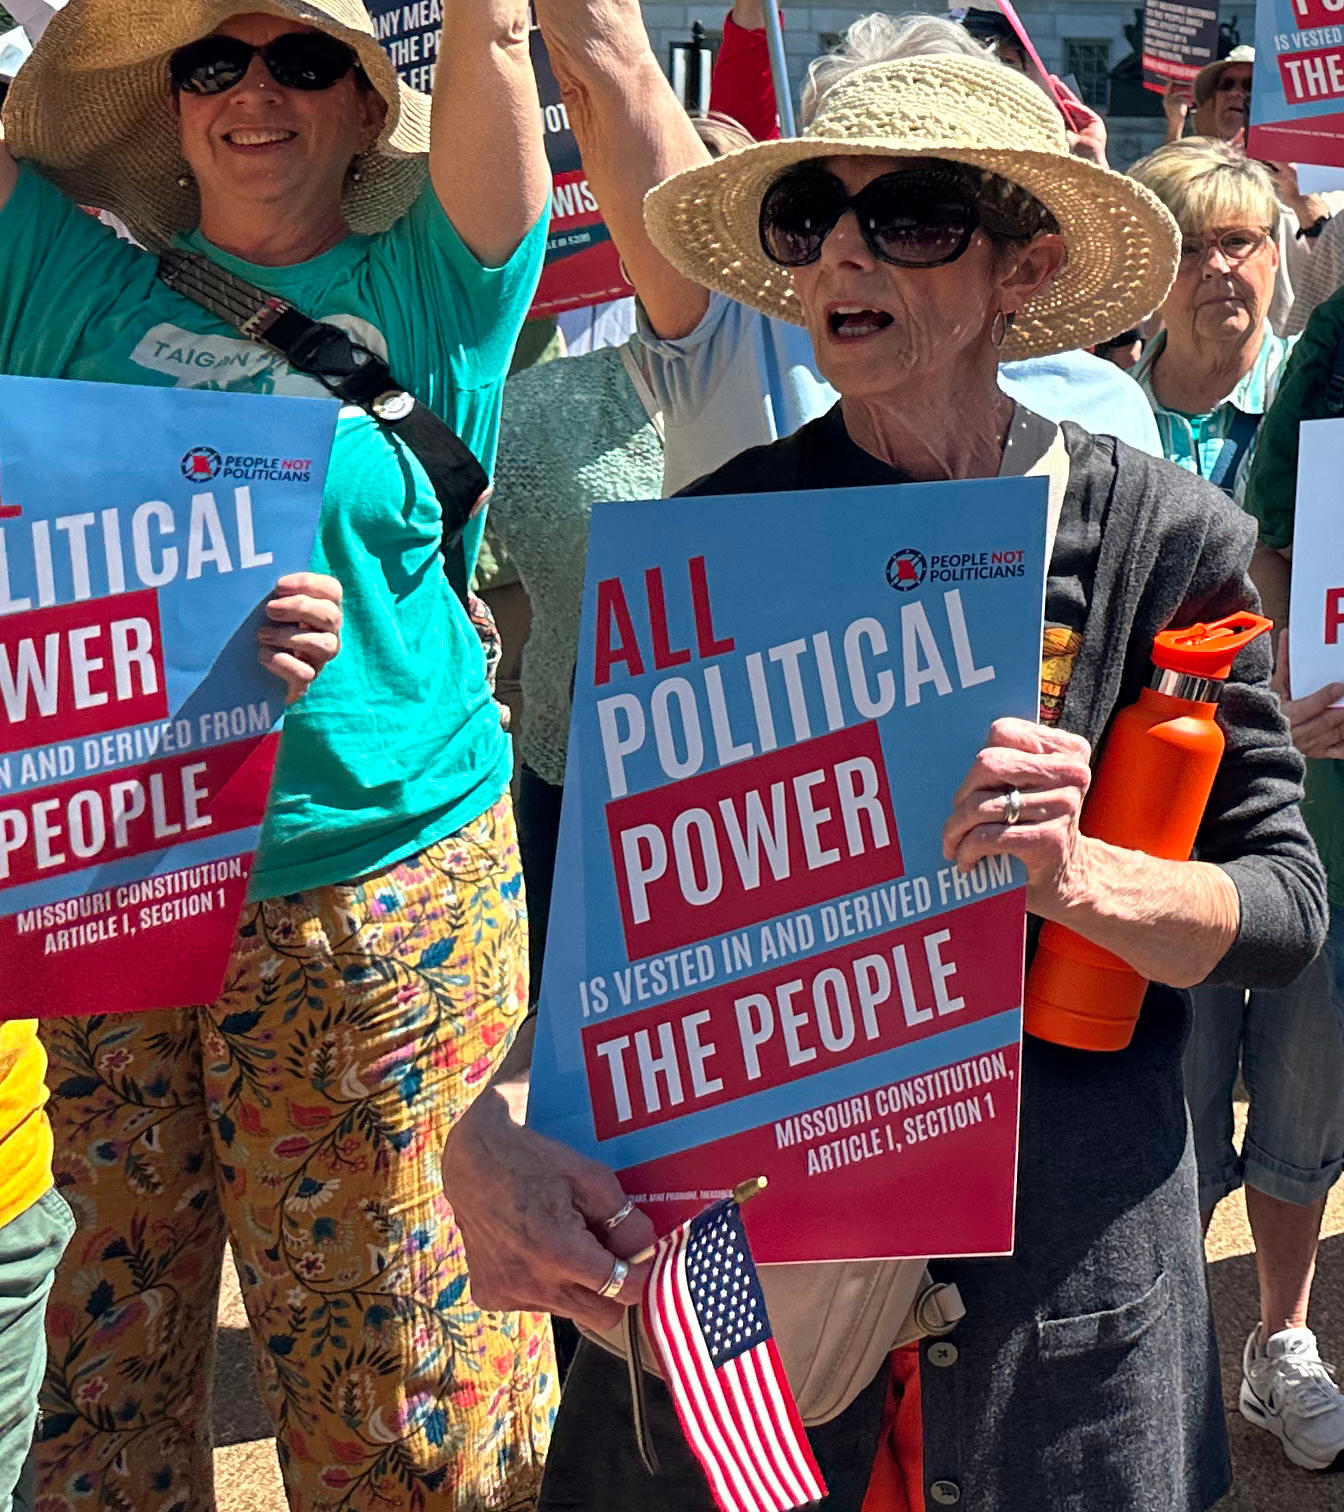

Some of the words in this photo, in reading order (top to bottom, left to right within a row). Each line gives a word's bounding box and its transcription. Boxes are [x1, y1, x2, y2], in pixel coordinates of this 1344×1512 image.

[1291, 28, 1341, 51] VESTED
[223, 467, 311, 483] POLITICIANS
[225, 456, 279, 470] PEOPLE
[281, 458, 312, 471] NOT
[0, 485, 273, 616] LITICAL
[929, 563, 1026, 583] POLITICIANS
[930, 553, 989, 569] PEOPLE
[990, 549, 1024, 565] NOT
[594, 554, 736, 685] ALL
[596, 587, 997, 800] POLITICAL
[20, 749, 75, 785] AND
[82, 716, 192, 770] DERIVED
[198, 702, 271, 743] FROM
[0, 760, 212, 880] PEOPLE
[619, 753, 893, 926] POWER
[16, 889, 112, 935] MISSOURI
[116, 856, 249, 909] CONSTITUTION,
[43, 915, 119, 956] ARTICLE
[139, 893, 213, 937] SECTION
[578, 977, 607, 1019] IS
[613, 946, 716, 1008] VESTED
[722, 935, 754, 976] IN
[759, 917, 815, 964] AND
[820, 876, 933, 946] DERIVED
[938, 853, 1015, 908] FROM
[596, 1009, 726, 1122] THE
[734, 928, 966, 1081] PEOPLE
[774, 1092, 873, 1150] MISSOURI
[875, 1052, 1015, 1125] CONSTITUTION,
[805, 1130, 884, 1176] ARTICLE
[905, 1103, 979, 1145] SECTION
